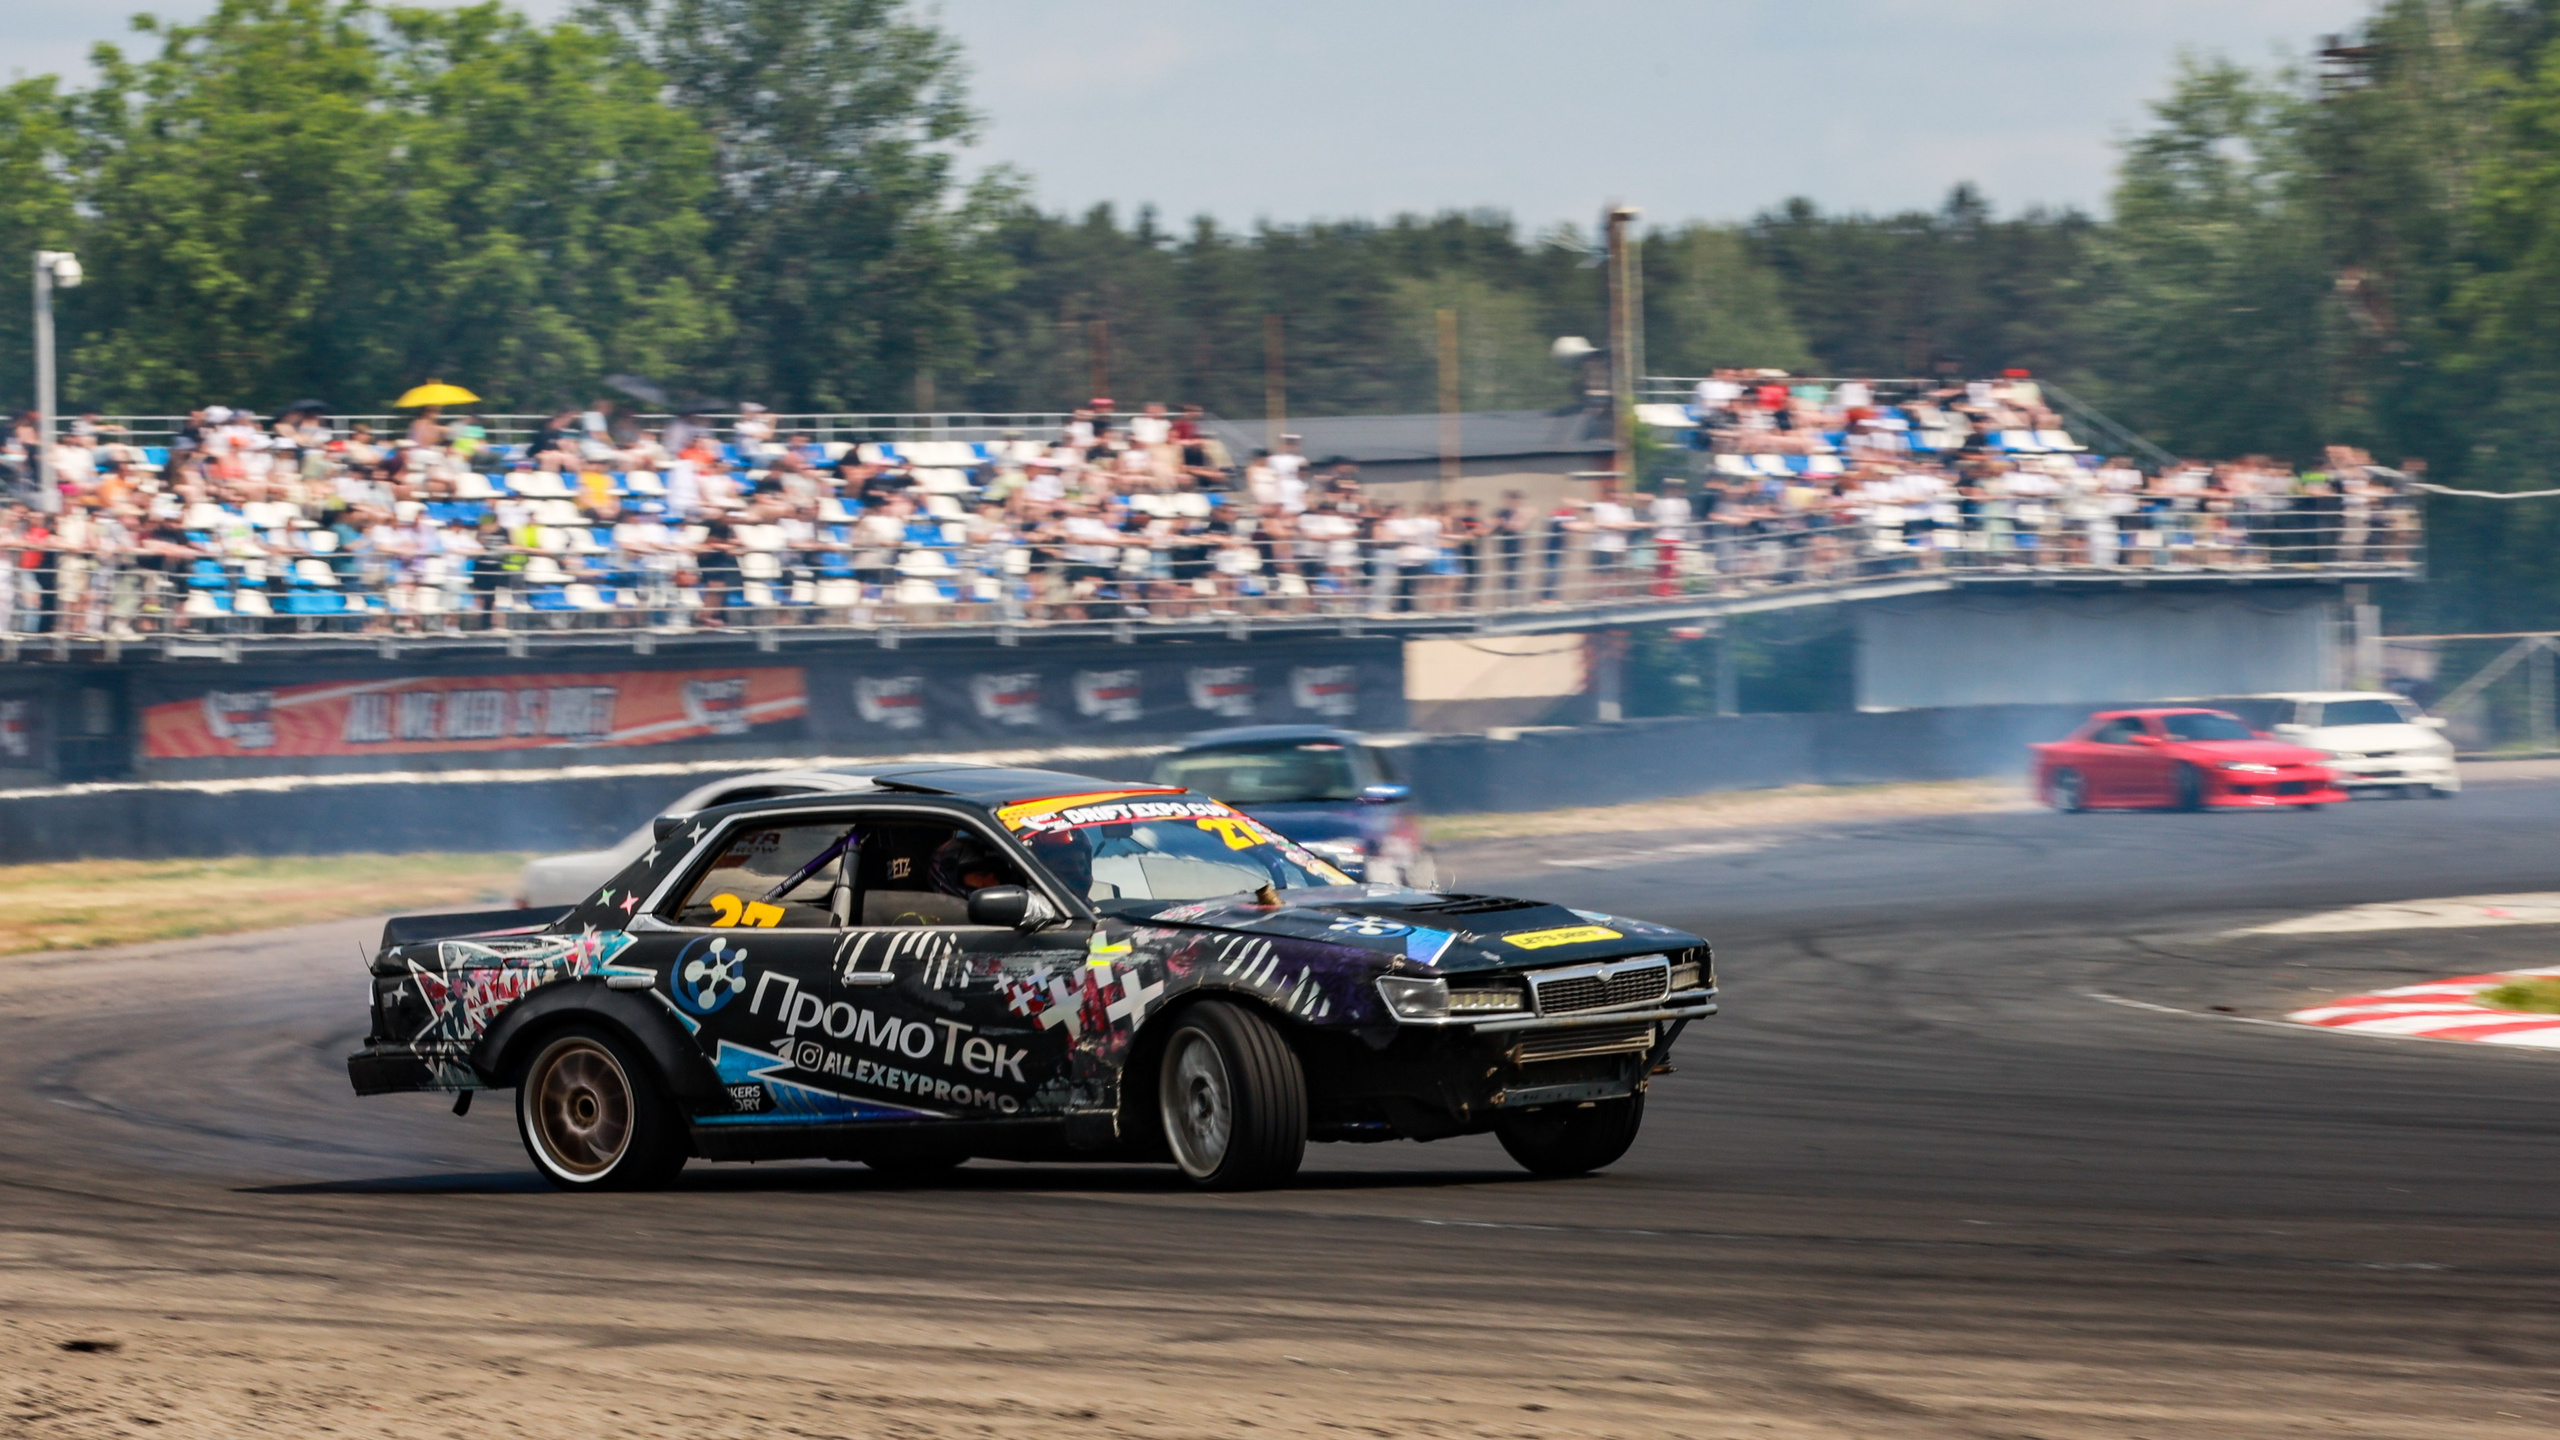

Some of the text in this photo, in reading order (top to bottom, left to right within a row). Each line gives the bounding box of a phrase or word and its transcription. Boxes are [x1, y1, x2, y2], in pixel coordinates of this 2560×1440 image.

[1063, 804, 1132, 825] DRIFT
[1128, 803, 1190, 817] EXPO
[1186, 803, 1231, 817] CUP
[1196, 817, 1267, 850] 27
[710, 893, 786, 928] 27
[749, 970, 1029, 1083] ПромоТек
[726, 1084, 761, 1098] KERS
